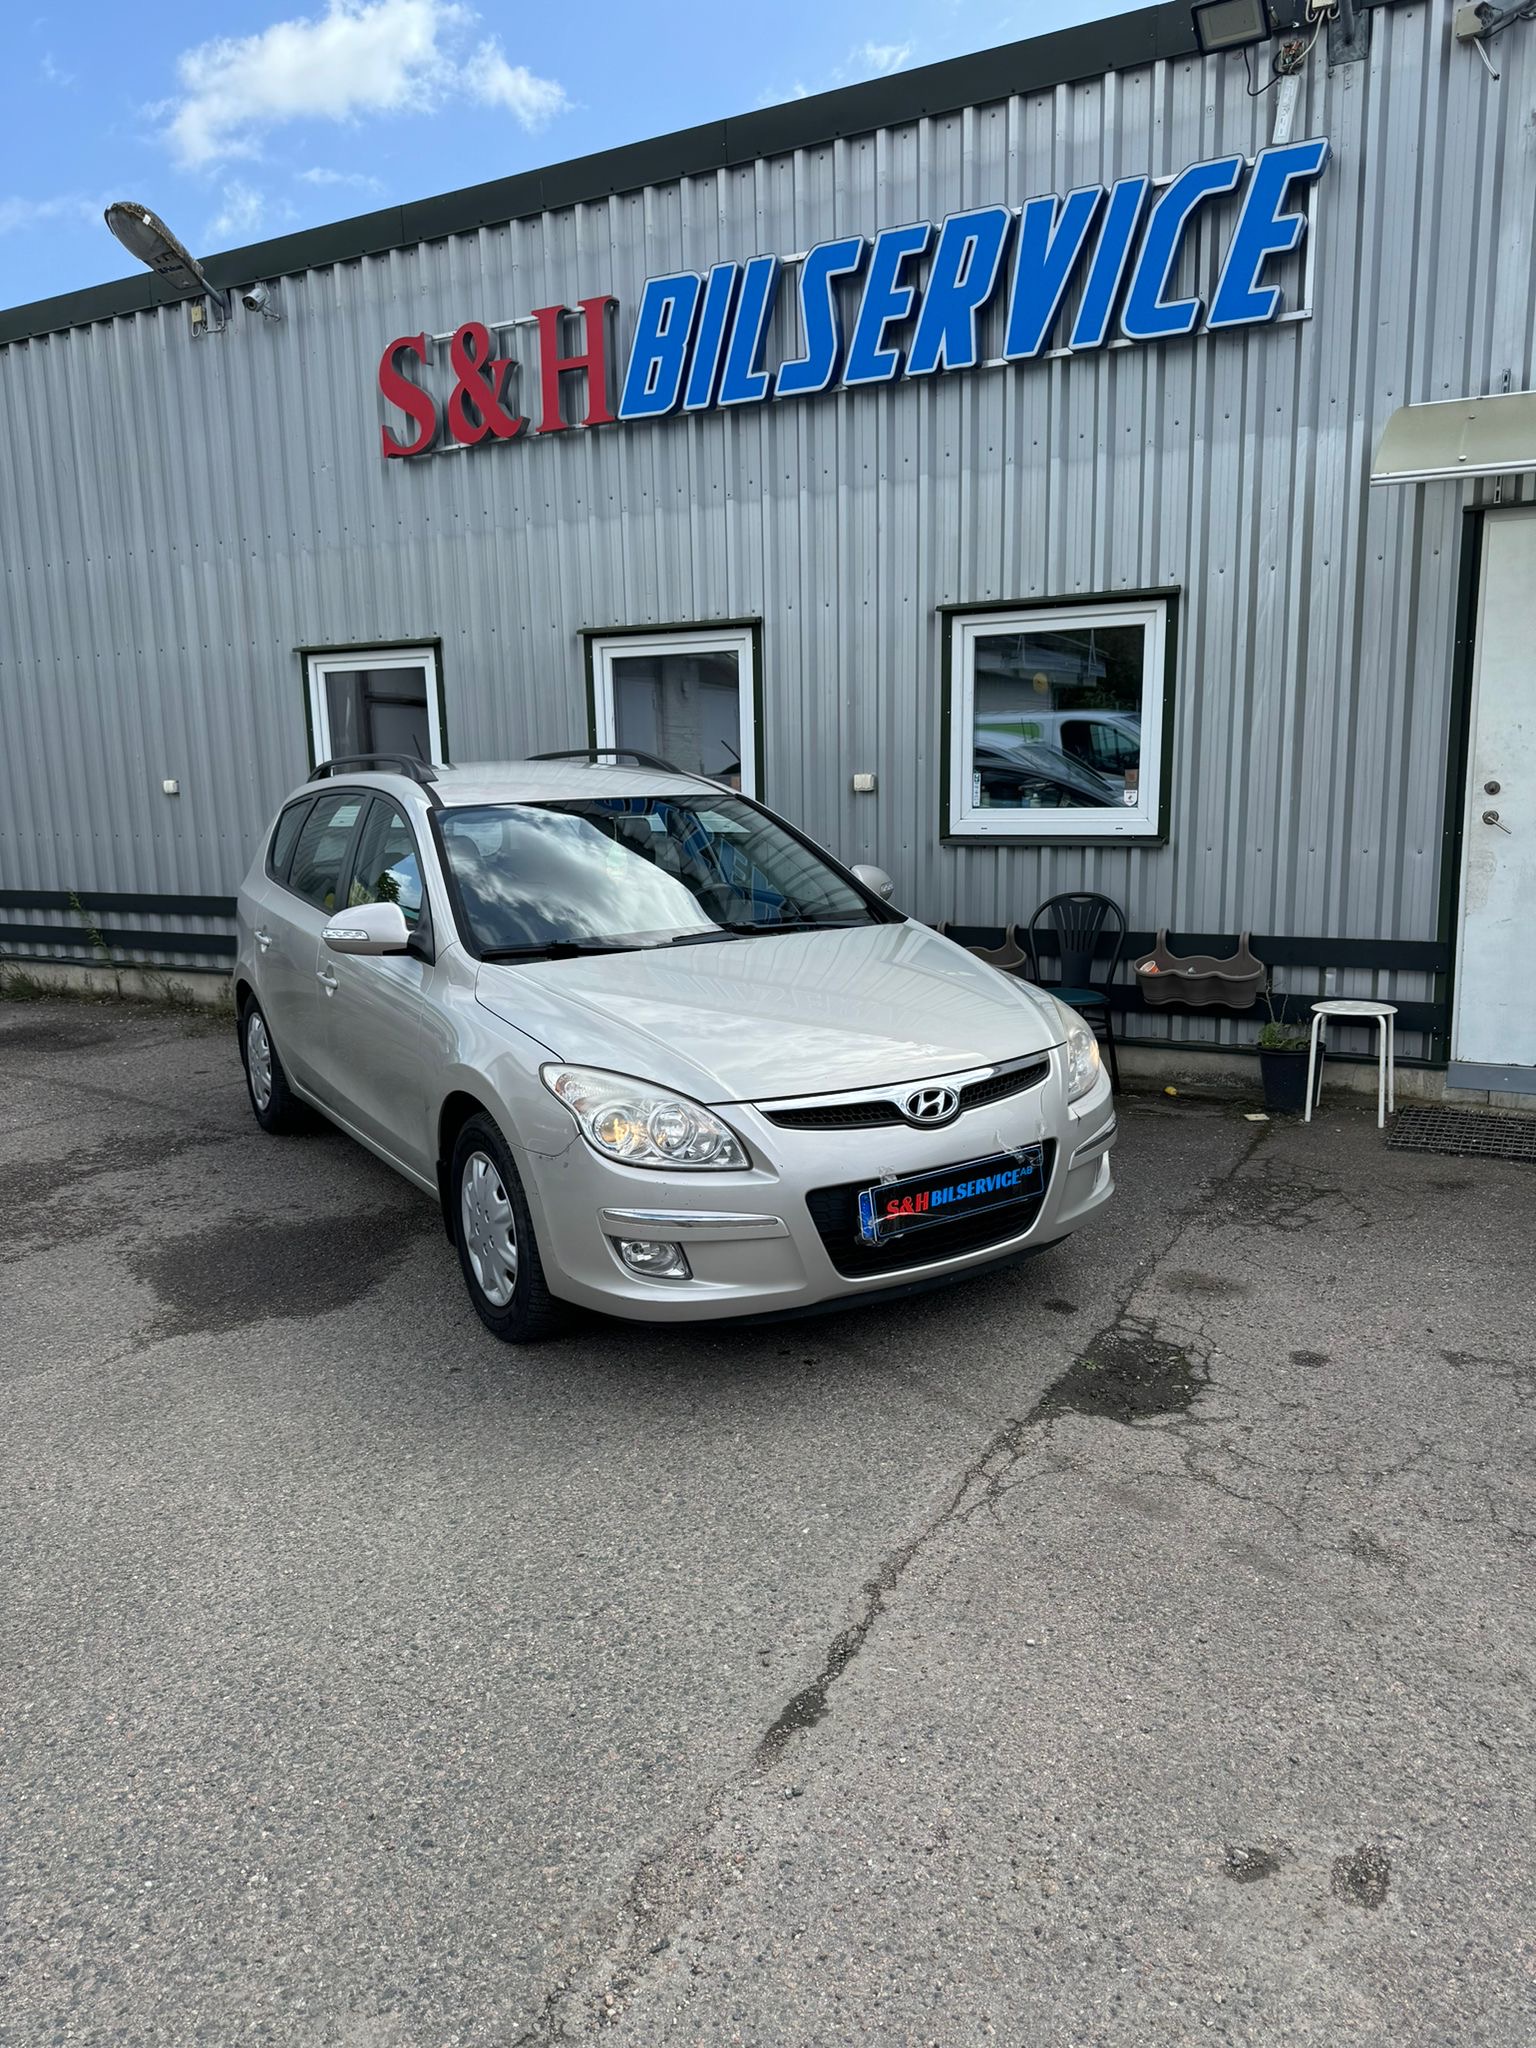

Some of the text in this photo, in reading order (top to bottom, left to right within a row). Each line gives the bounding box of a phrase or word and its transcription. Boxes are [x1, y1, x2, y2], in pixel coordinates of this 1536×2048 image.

[379, 136, 1330, 459] S&H BILSERVICE
[886, 1191, 930, 1219] S&H
[931, 1168, 1021, 1206] BILSERVICE
